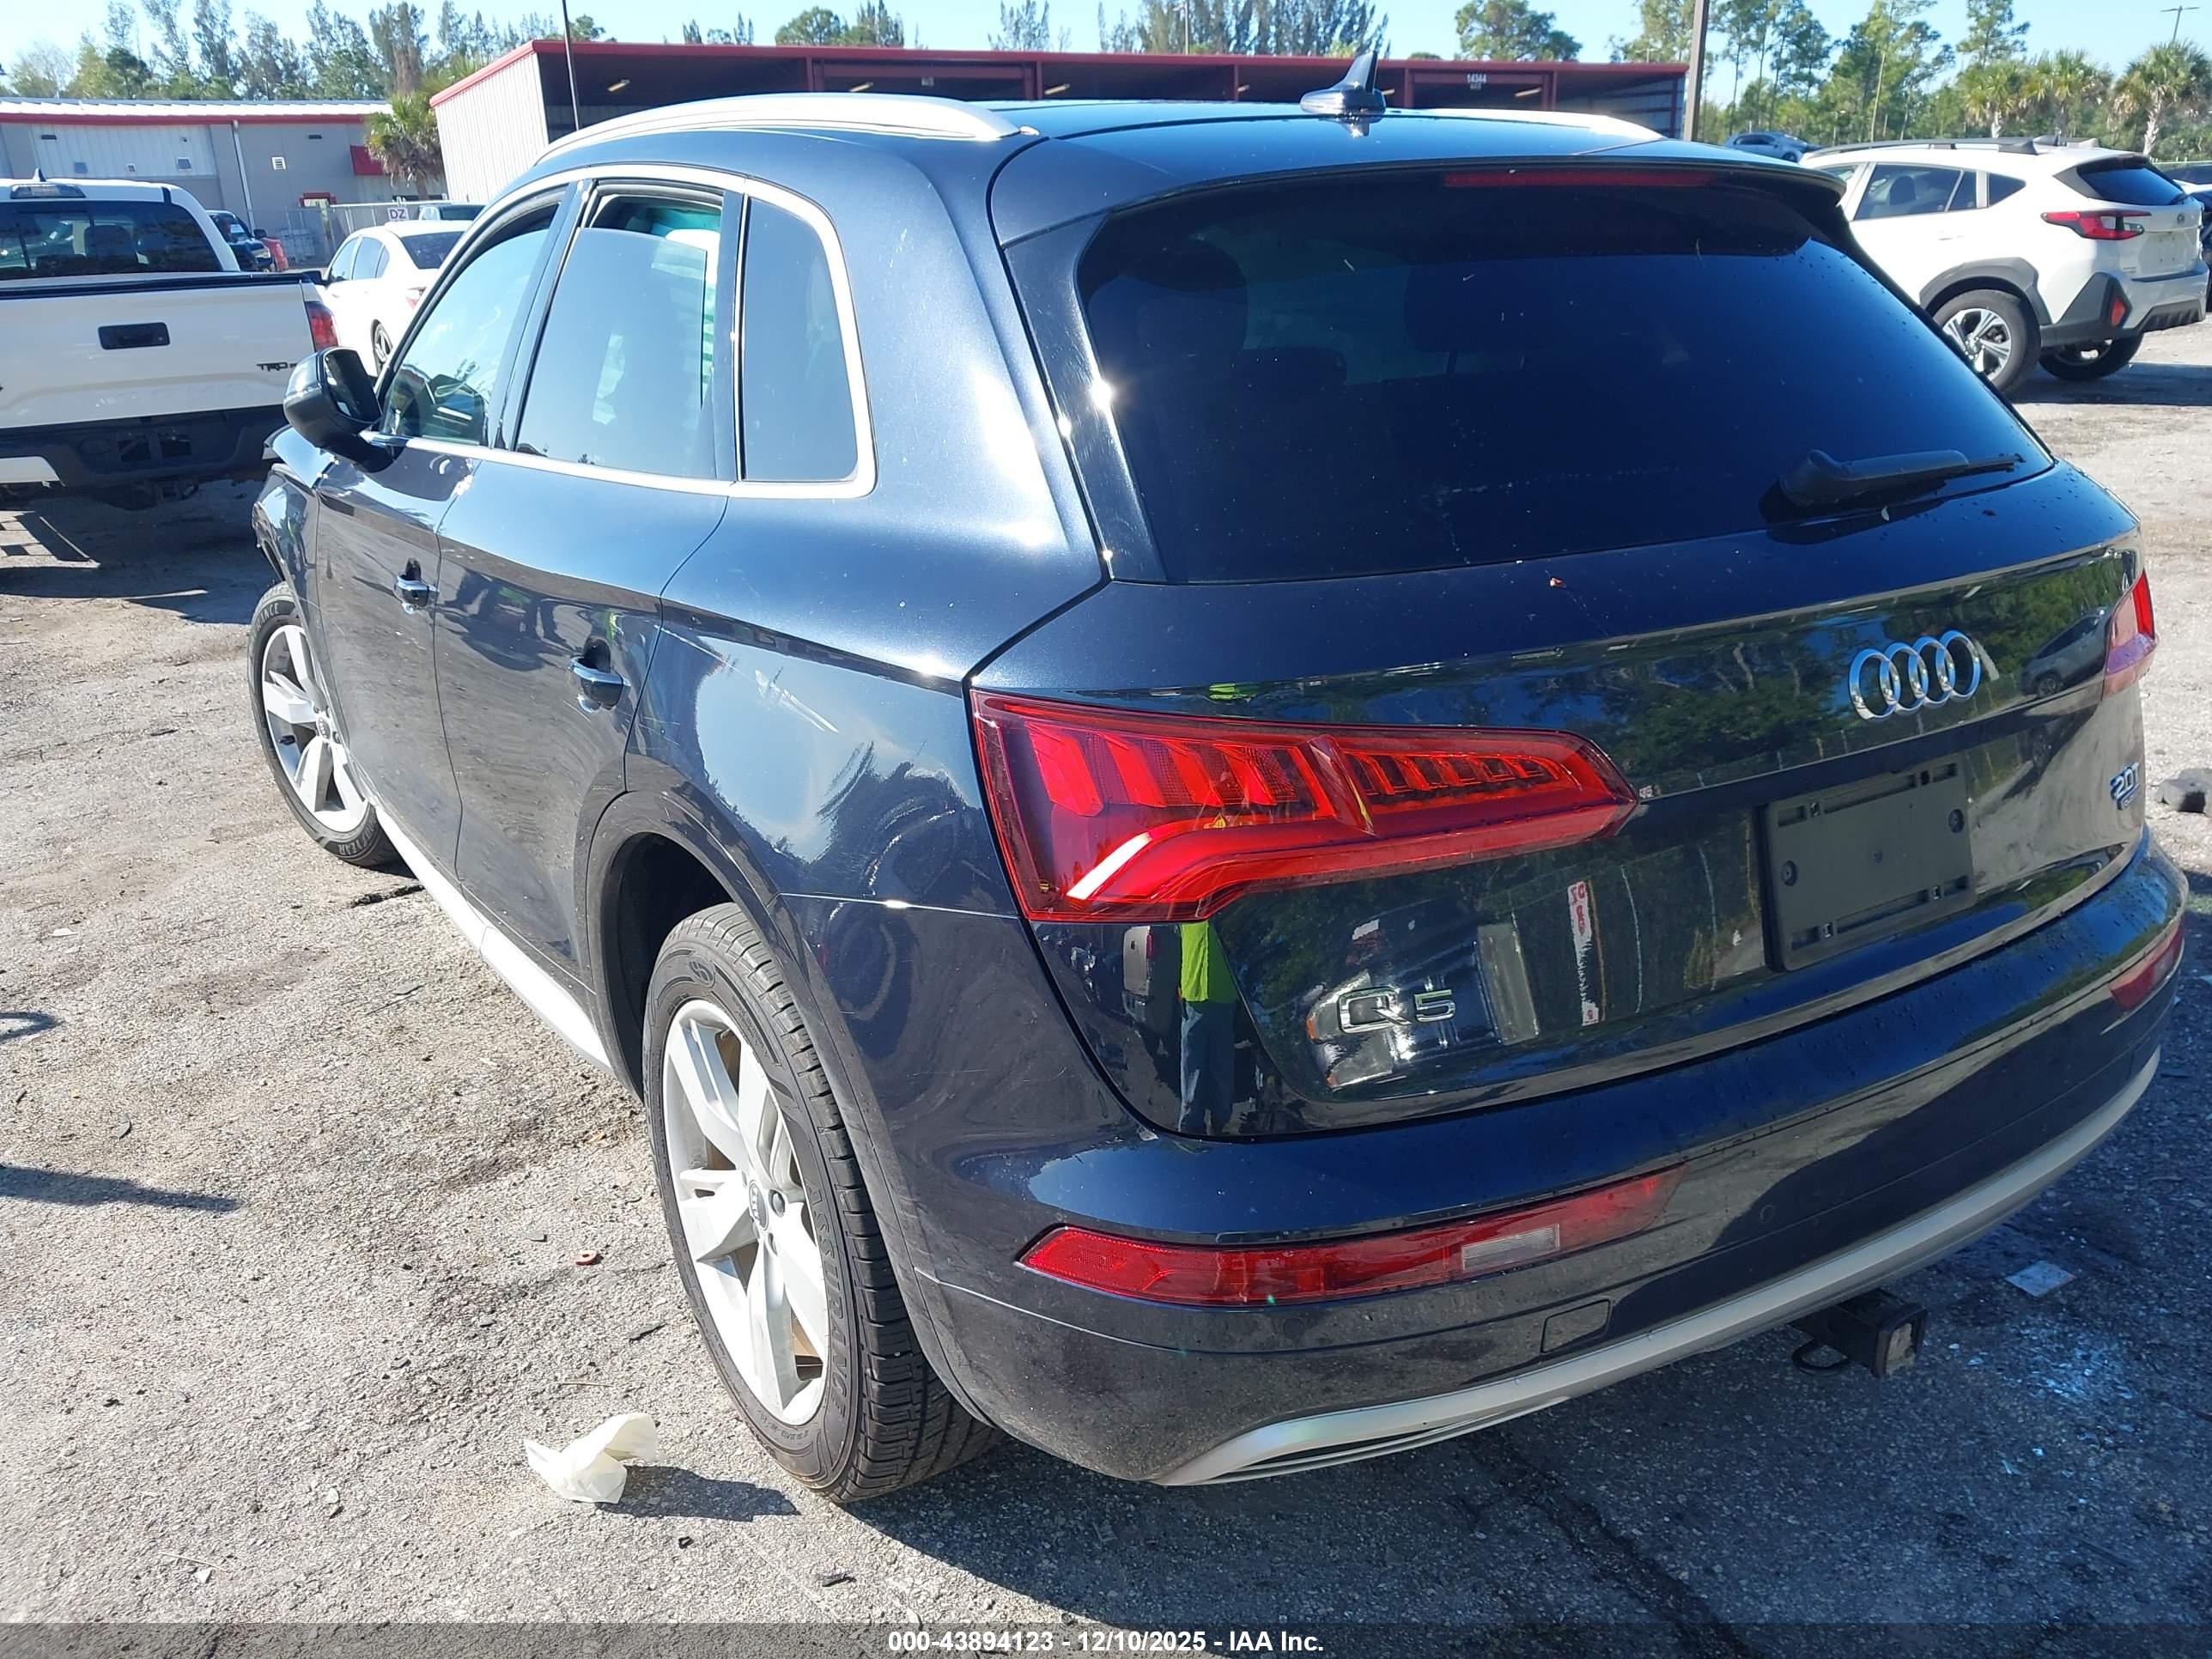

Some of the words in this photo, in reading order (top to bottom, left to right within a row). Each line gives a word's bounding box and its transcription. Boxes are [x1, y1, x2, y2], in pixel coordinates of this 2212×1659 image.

[389, 209, 406, 219] DZ
[256, 362, 288, 371] TRD
[1336, 987, 1456, 1033] Q5
